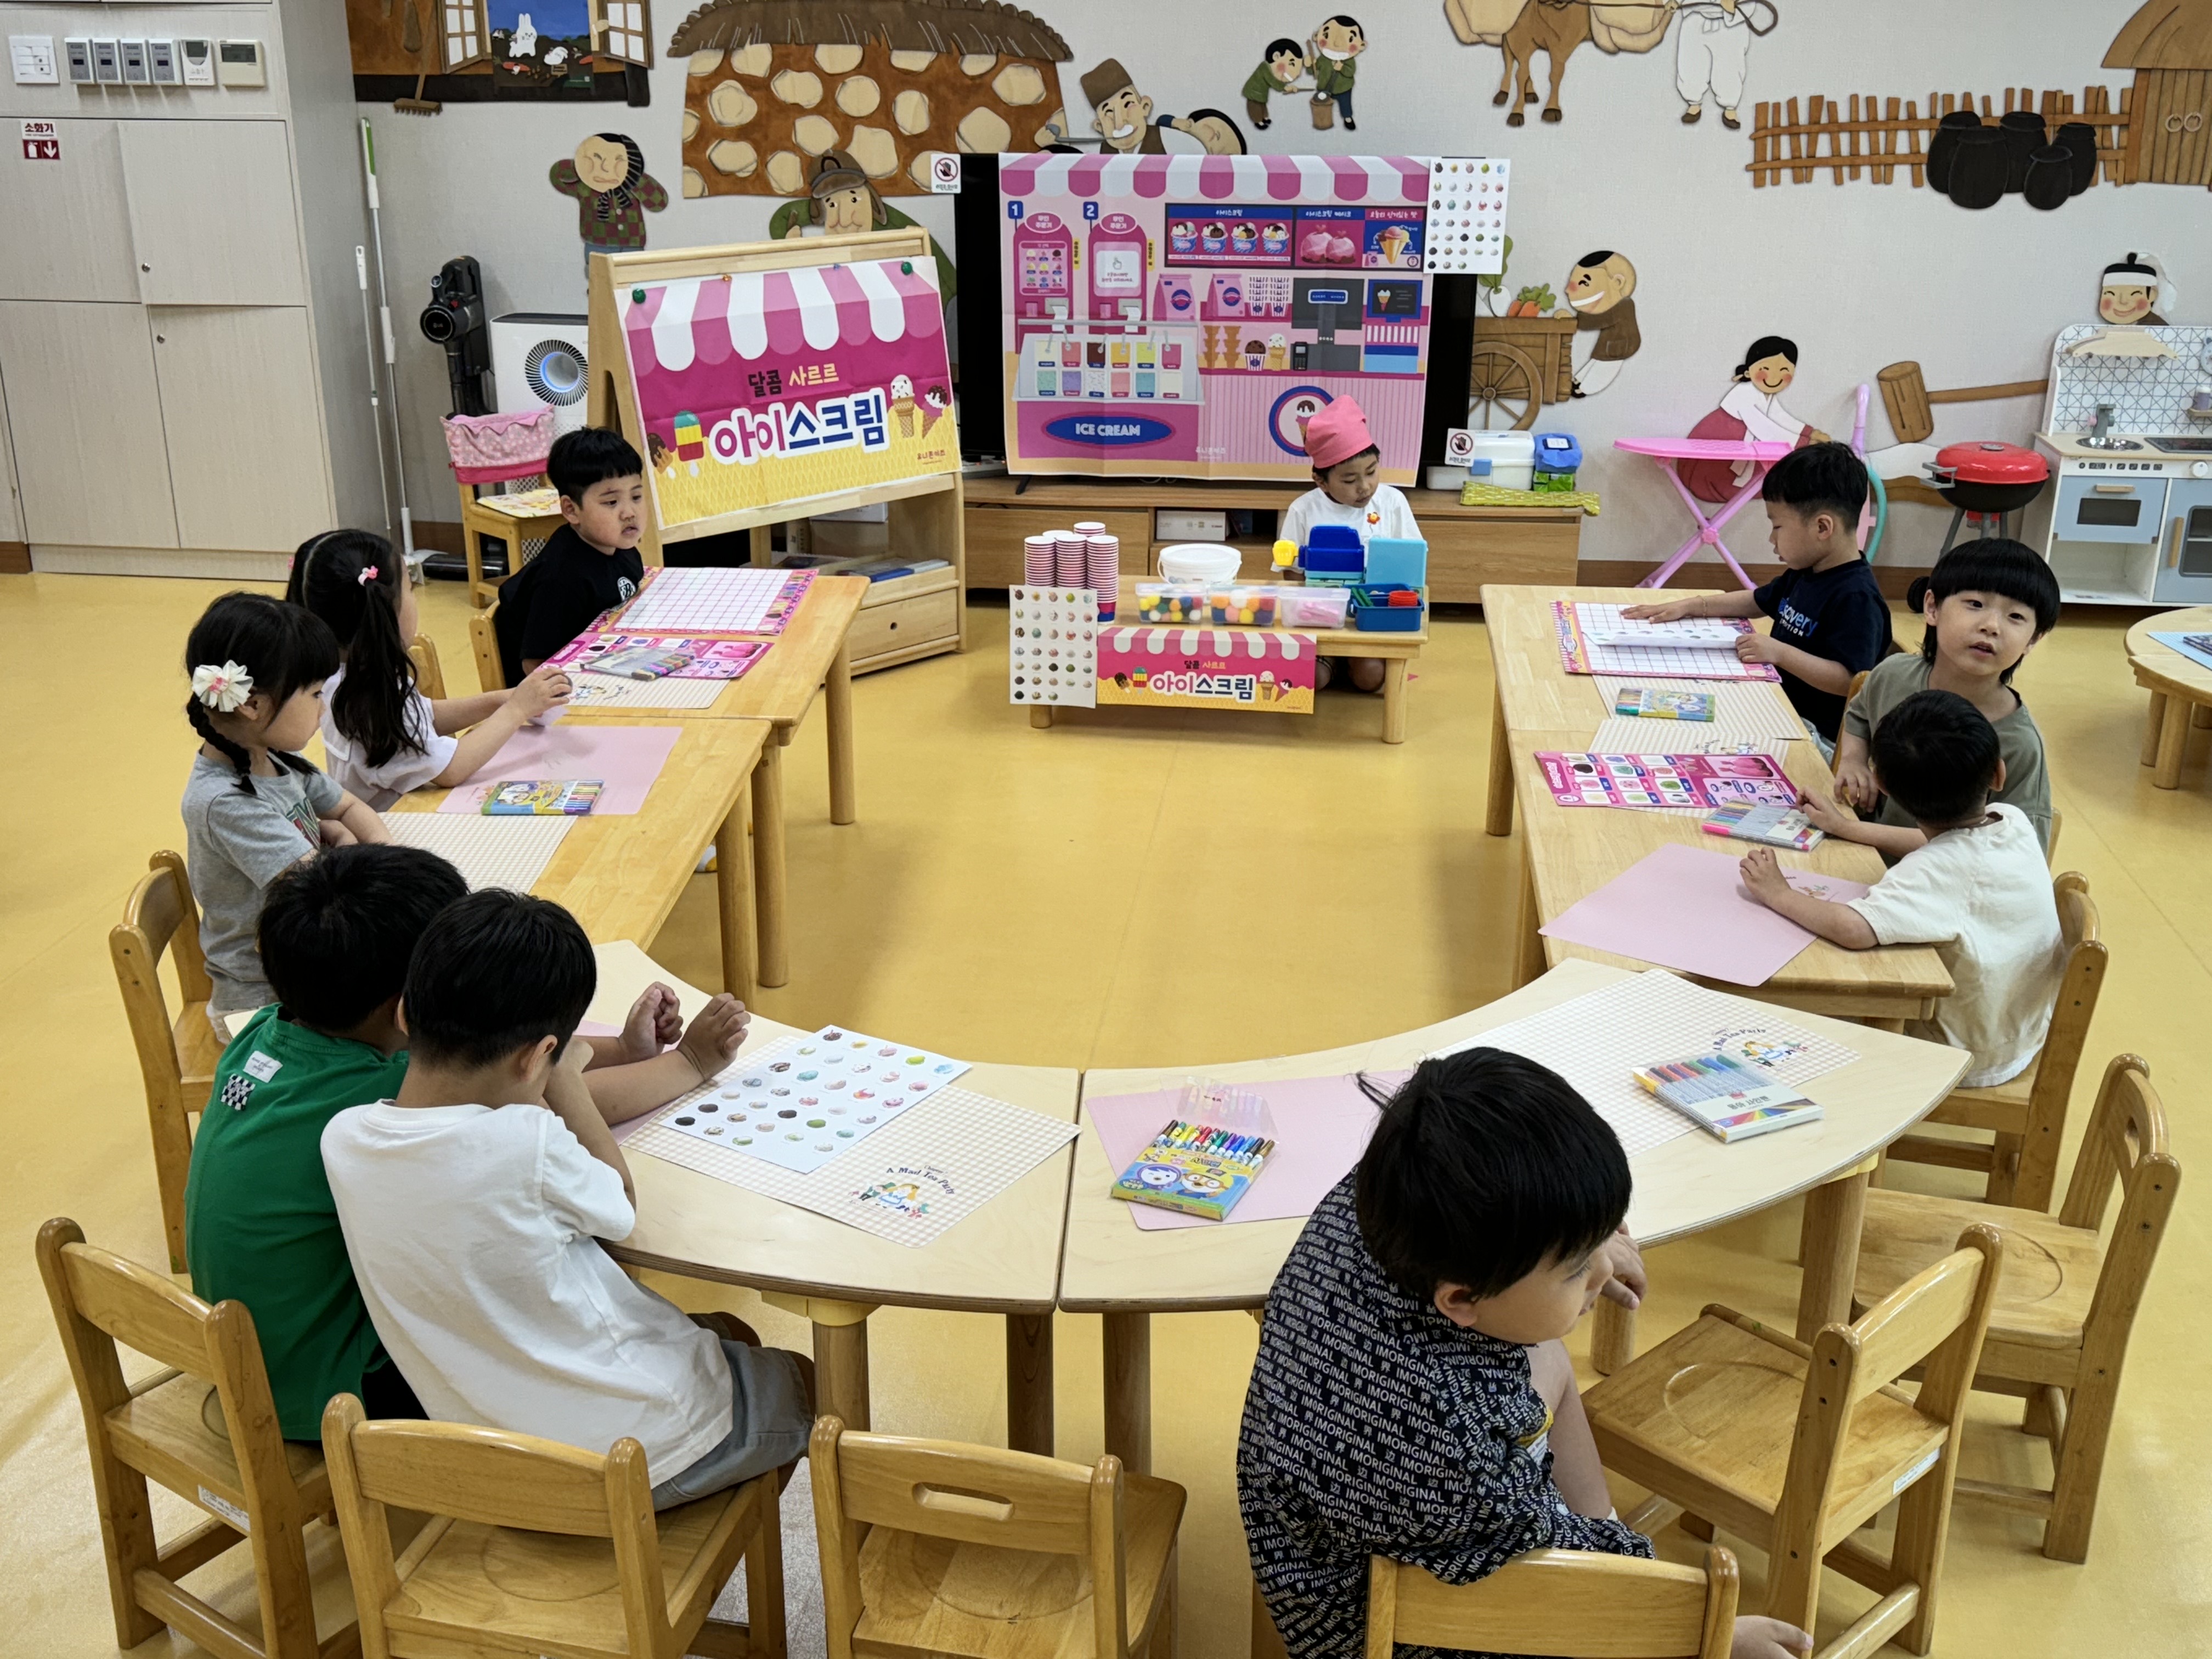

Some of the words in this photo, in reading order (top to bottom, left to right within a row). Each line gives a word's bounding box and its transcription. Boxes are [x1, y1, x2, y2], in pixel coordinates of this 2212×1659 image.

[25, 123, 54, 133] 소화기
[1012, 204, 1018, 216] 1
[1086, 205, 1094, 217] 2
[1216, 209, 1243, 217] 아이스크림
[748, 369, 782, 397] 달콤
[788, 363, 839, 387] 사르르
[713, 392, 887, 460] 아이스크림
[1075, 423, 1095, 436] ICE
[1097, 424, 1141, 437] CREAM
[1184, 660, 1200, 670] 달콤
[1202, 661, 1226, 669] 사르르
[1153, 673, 1253, 700] 아이스크림
[898, 1167, 922, 1176] Mad
[923, 1171, 938, 1181] Tea
[938, 1179, 955, 1194] Party
[1333, 1296, 1380, 1328] IMORIGINAL
[1322, 1333, 1374, 1368] IMORIGINAL
[1347, 1317, 1402, 1351] IMORIGINAL
[1300, 1351, 1350, 1385] IMORIGINAL
[1367, 1384, 1435, 1422] IMORIGINAL
[1326, 1379, 1384, 1414] IMORIGINAL
[1351, 1362, 1413, 1398] IMORIGINAL
[1301, 1395, 1357, 1431] IMORIGINAL
[1378, 1431, 1447, 1468] IMORIGINAL
[1314, 1417, 1376, 1454] IMORIGINAL
[1342, 1401, 1404, 1438] IMORIGINAL
[1322, 1464, 1390, 1500] IMORIGINAL
[1350, 1448, 1417, 1485] IMORIGINAL
[1266, 1451, 1321, 1487] IMORIGINAL
[1346, 1488, 1416, 1521] IMORIGINAL
[1299, 1481, 1363, 1515] IMORIGINAL
[1373, 1472, 1444, 1503] IMORIGINAL
